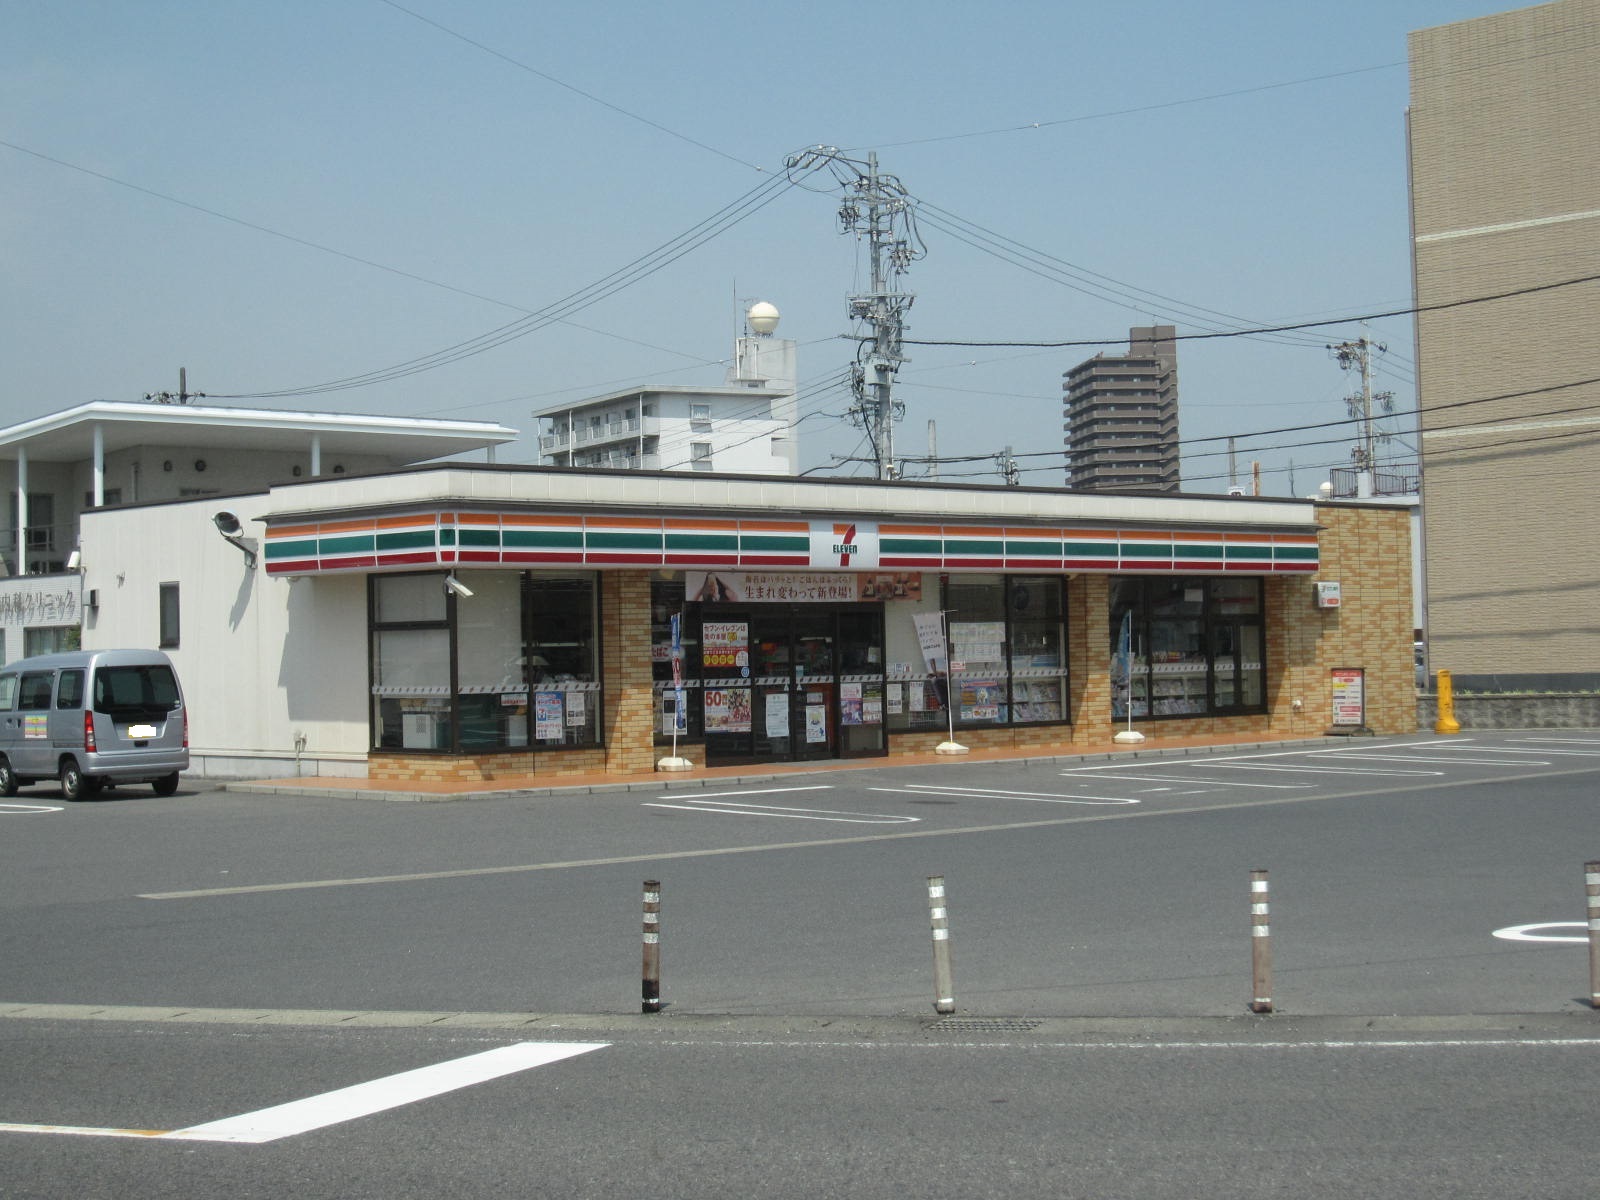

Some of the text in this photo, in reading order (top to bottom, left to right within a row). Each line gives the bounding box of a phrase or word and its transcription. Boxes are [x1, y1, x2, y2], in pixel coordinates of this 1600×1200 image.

[833, 523, 856, 566] 7
[744, 586, 852, 599] 生まれ変わって新登場!
[705, 691, 721, 706] 50
